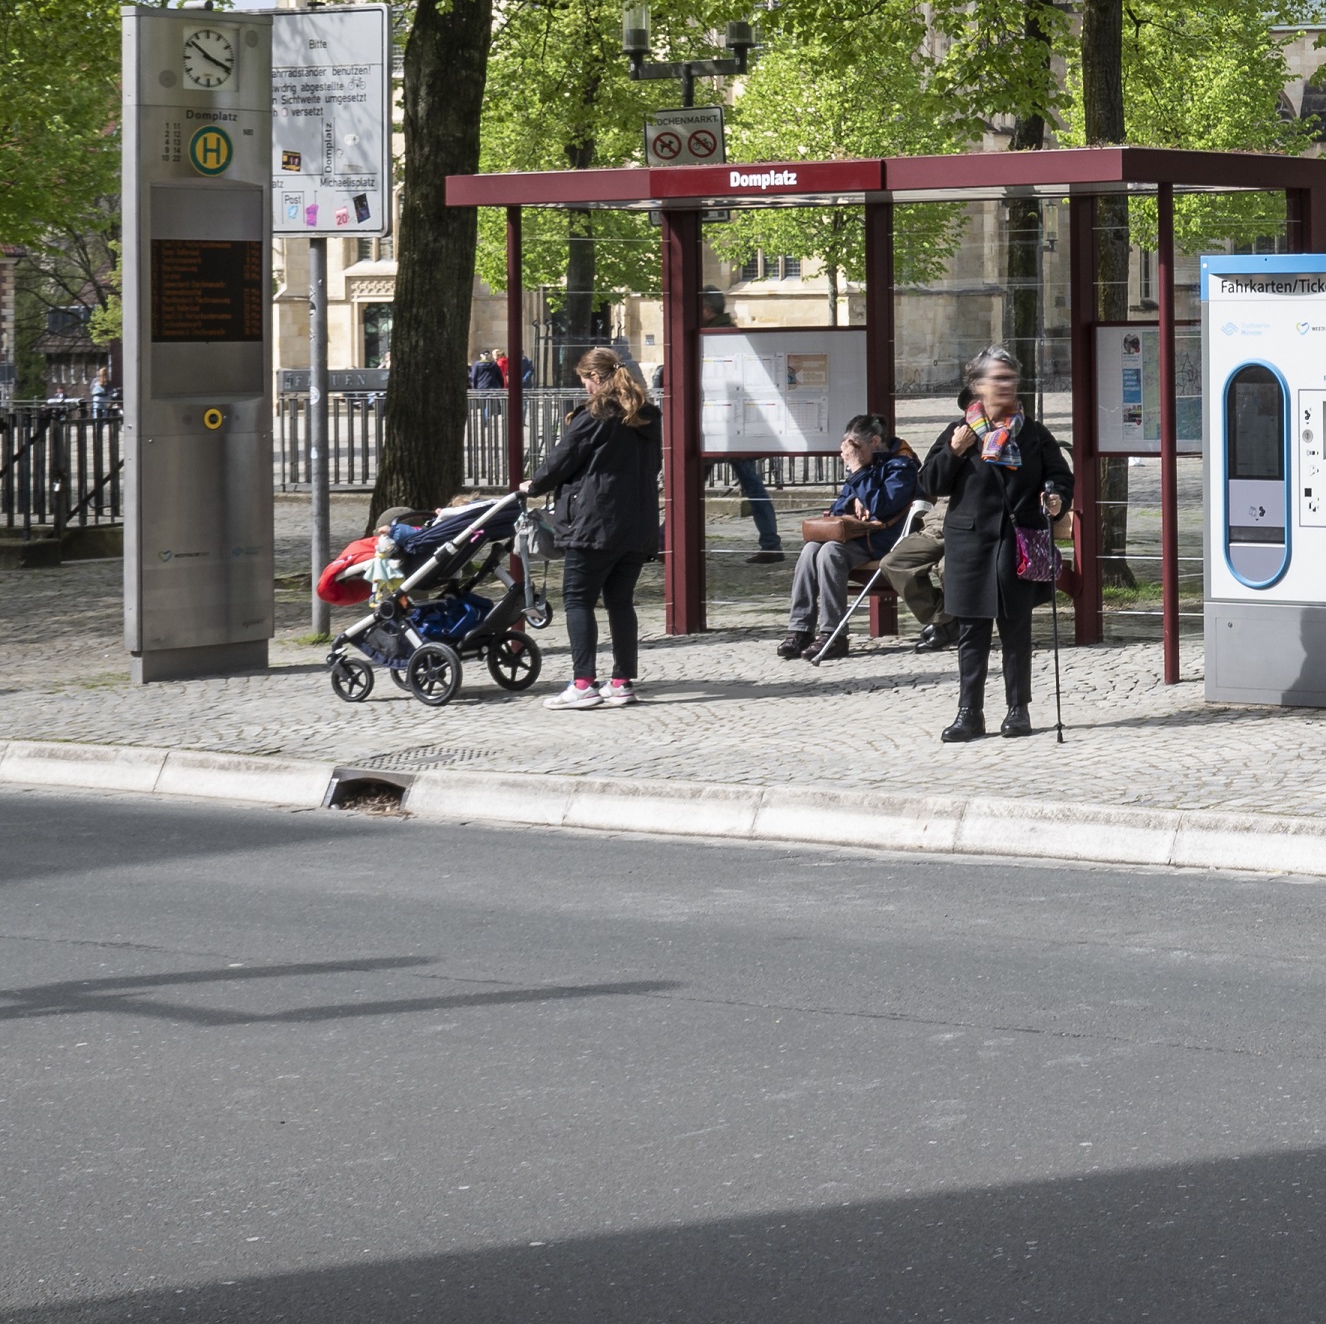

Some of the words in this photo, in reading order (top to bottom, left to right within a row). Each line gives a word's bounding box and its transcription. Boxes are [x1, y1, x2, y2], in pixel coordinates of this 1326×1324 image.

[308, 39, 327, 49] Bitte
[332, 65, 371, 76] benutzen!
[300, 81, 344, 94] abgestellte
[281, 94, 321, 105] Sichtweite
[325, 93, 367, 105] umgesetzt
[186, 109, 238, 122] Domplatz
[291, 107, 324, 116] versetzt
[650, 113, 719, 126] OCHENMARKT
[324, 122, 334, 174] Domplatz
[320, 176, 376, 189] Michaelisplatz
[730, 170, 798, 190] Domplatz
[284, 194, 302, 204] Post
